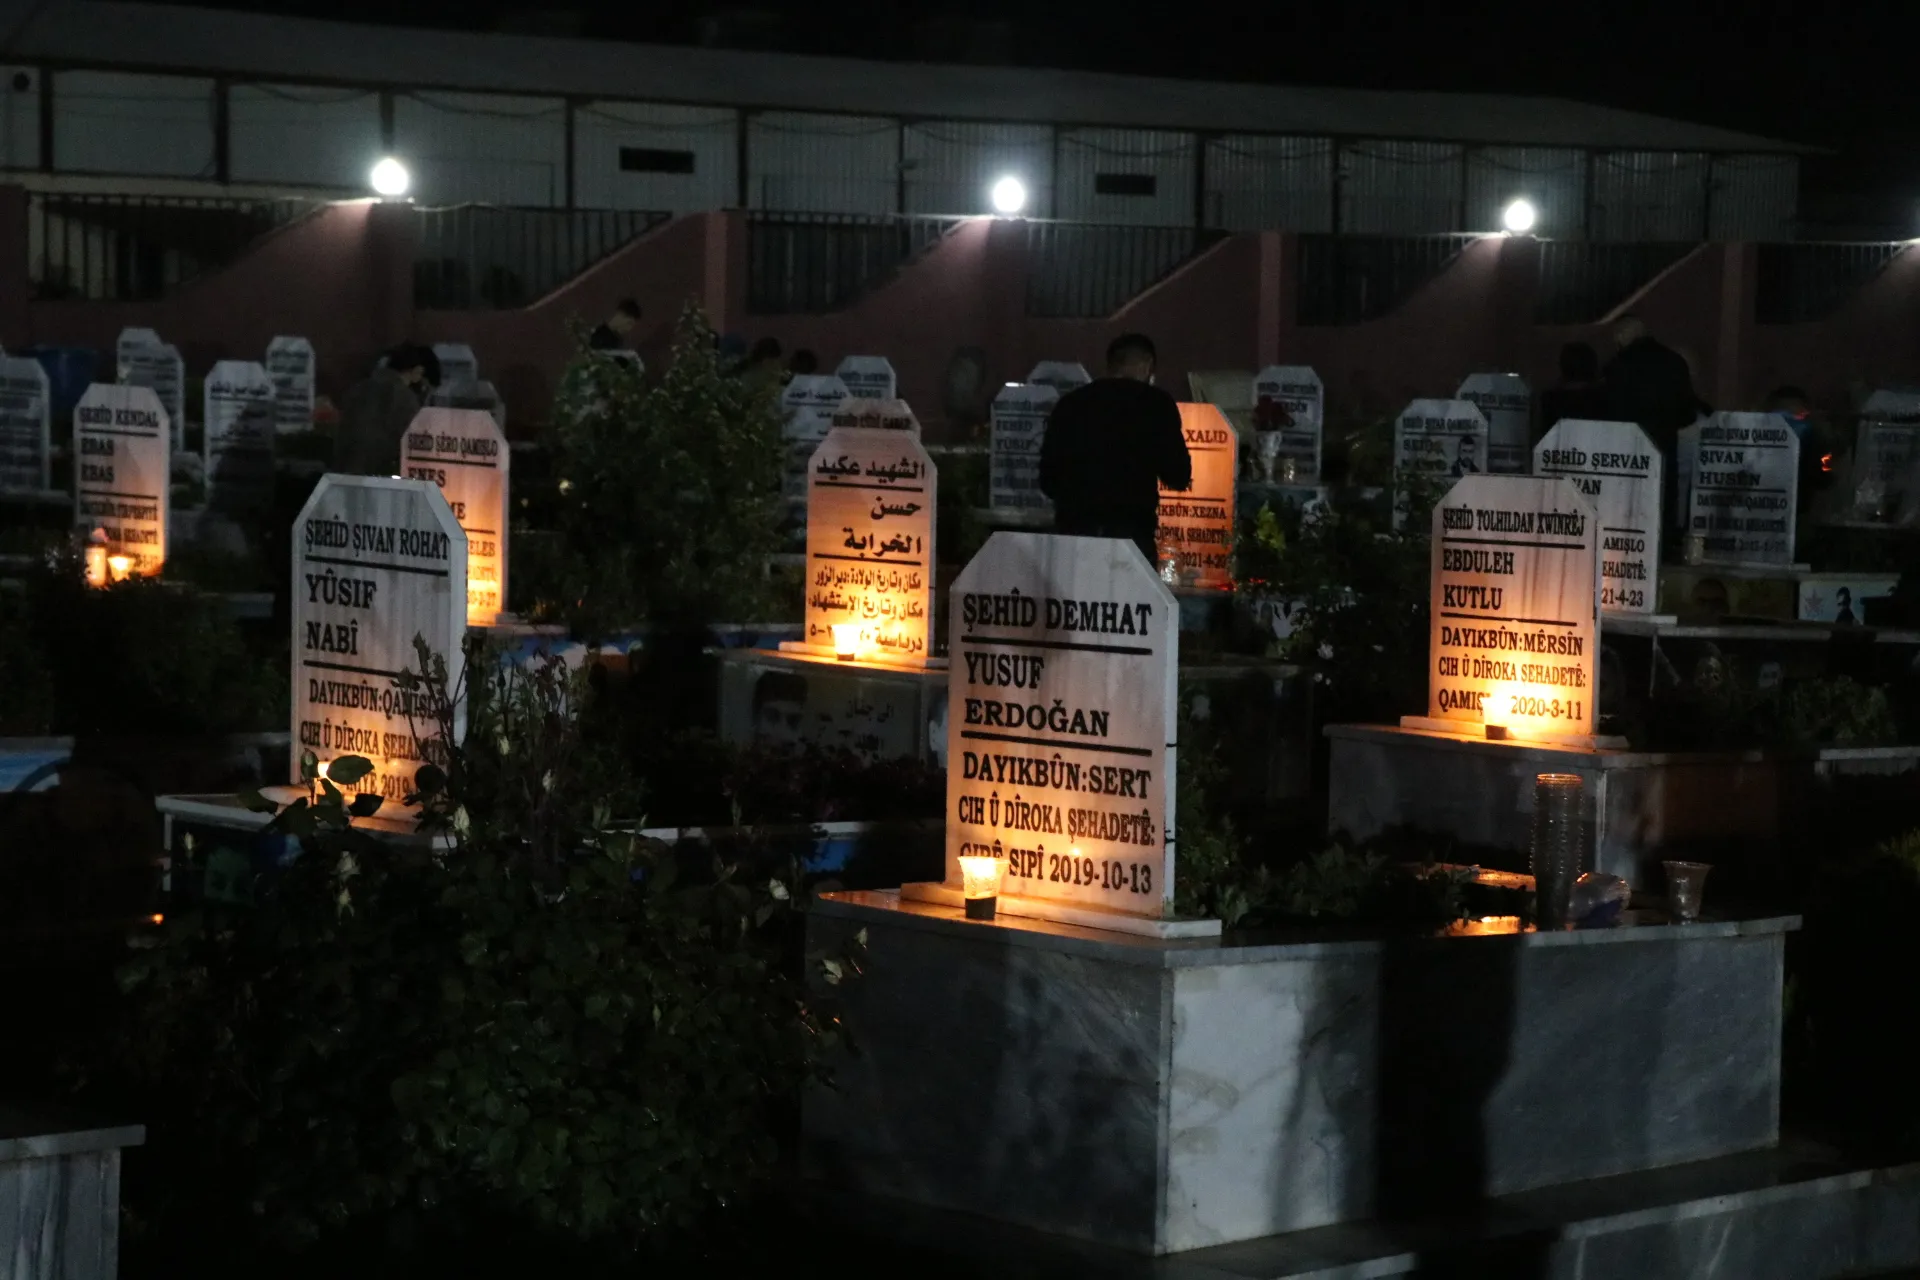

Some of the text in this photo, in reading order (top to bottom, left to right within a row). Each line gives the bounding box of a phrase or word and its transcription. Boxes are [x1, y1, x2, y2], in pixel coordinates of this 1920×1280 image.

[1185, 429, 1228, 443] XALID
[816, 456, 925, 484] الشهيد عكيد
[1542, 447, 1650, 471] ŞEHÎD ŞERVAN
[1700, 450, 1744, 465] ŞIVAN
[870, 496, 922, 520] حسن
[1443, 503, 1586, 537] ŞEHÎD TOLHILDAN XWÎNRÊJ
[305, 514, 450, 560] ŞEHÎD ŞIVAN ROHAT
[843, 527, 922, 560] الخرابة
[1603, 537, 1645, 556] AMIŞLO
[1442, 548, 1515, 575] EBDULEH
[1602, 560, 1647, 581] EHADETÊ:
[306, 568, 377, 609] YÛSIF
[1443, 584, 1504, 611] KUTLU
[1601, 588, 1644, 608] 21-4-23
[963, 587, 1153, 637] ŞEHÎD DEMHAT
[306, 619, 358, 656] NABÎ
[1441, 625, 1584, 656] DAYIKBÛN:MÊRSÎN
[964, 650, 1045, 689] YUSUF
[1439, 655, 1459, 676] CIH
[1462, 654, 1470, 677] Û
[1473, 655, 1517, 681] DÎROKA
[964, 698, 1110, 738] ERDOĞAN
[1439, 689, 1583, 721] QAMIŞ 2020-3-11
[301, 720, 321, 746] CIH
[324, 718, 332, 747] Û
[335, 720, 380, 756] DÎROKA
[963, 750, 1152, 799] DAYIKBÛN:SERT
[958, 794, 1156, 847] CIH Û DÎROKA ŞEHADETÊ:
[1009, 844, 1044, 880] SIPÎ
[1050, 853, 1152, 894] 2019-10-13
